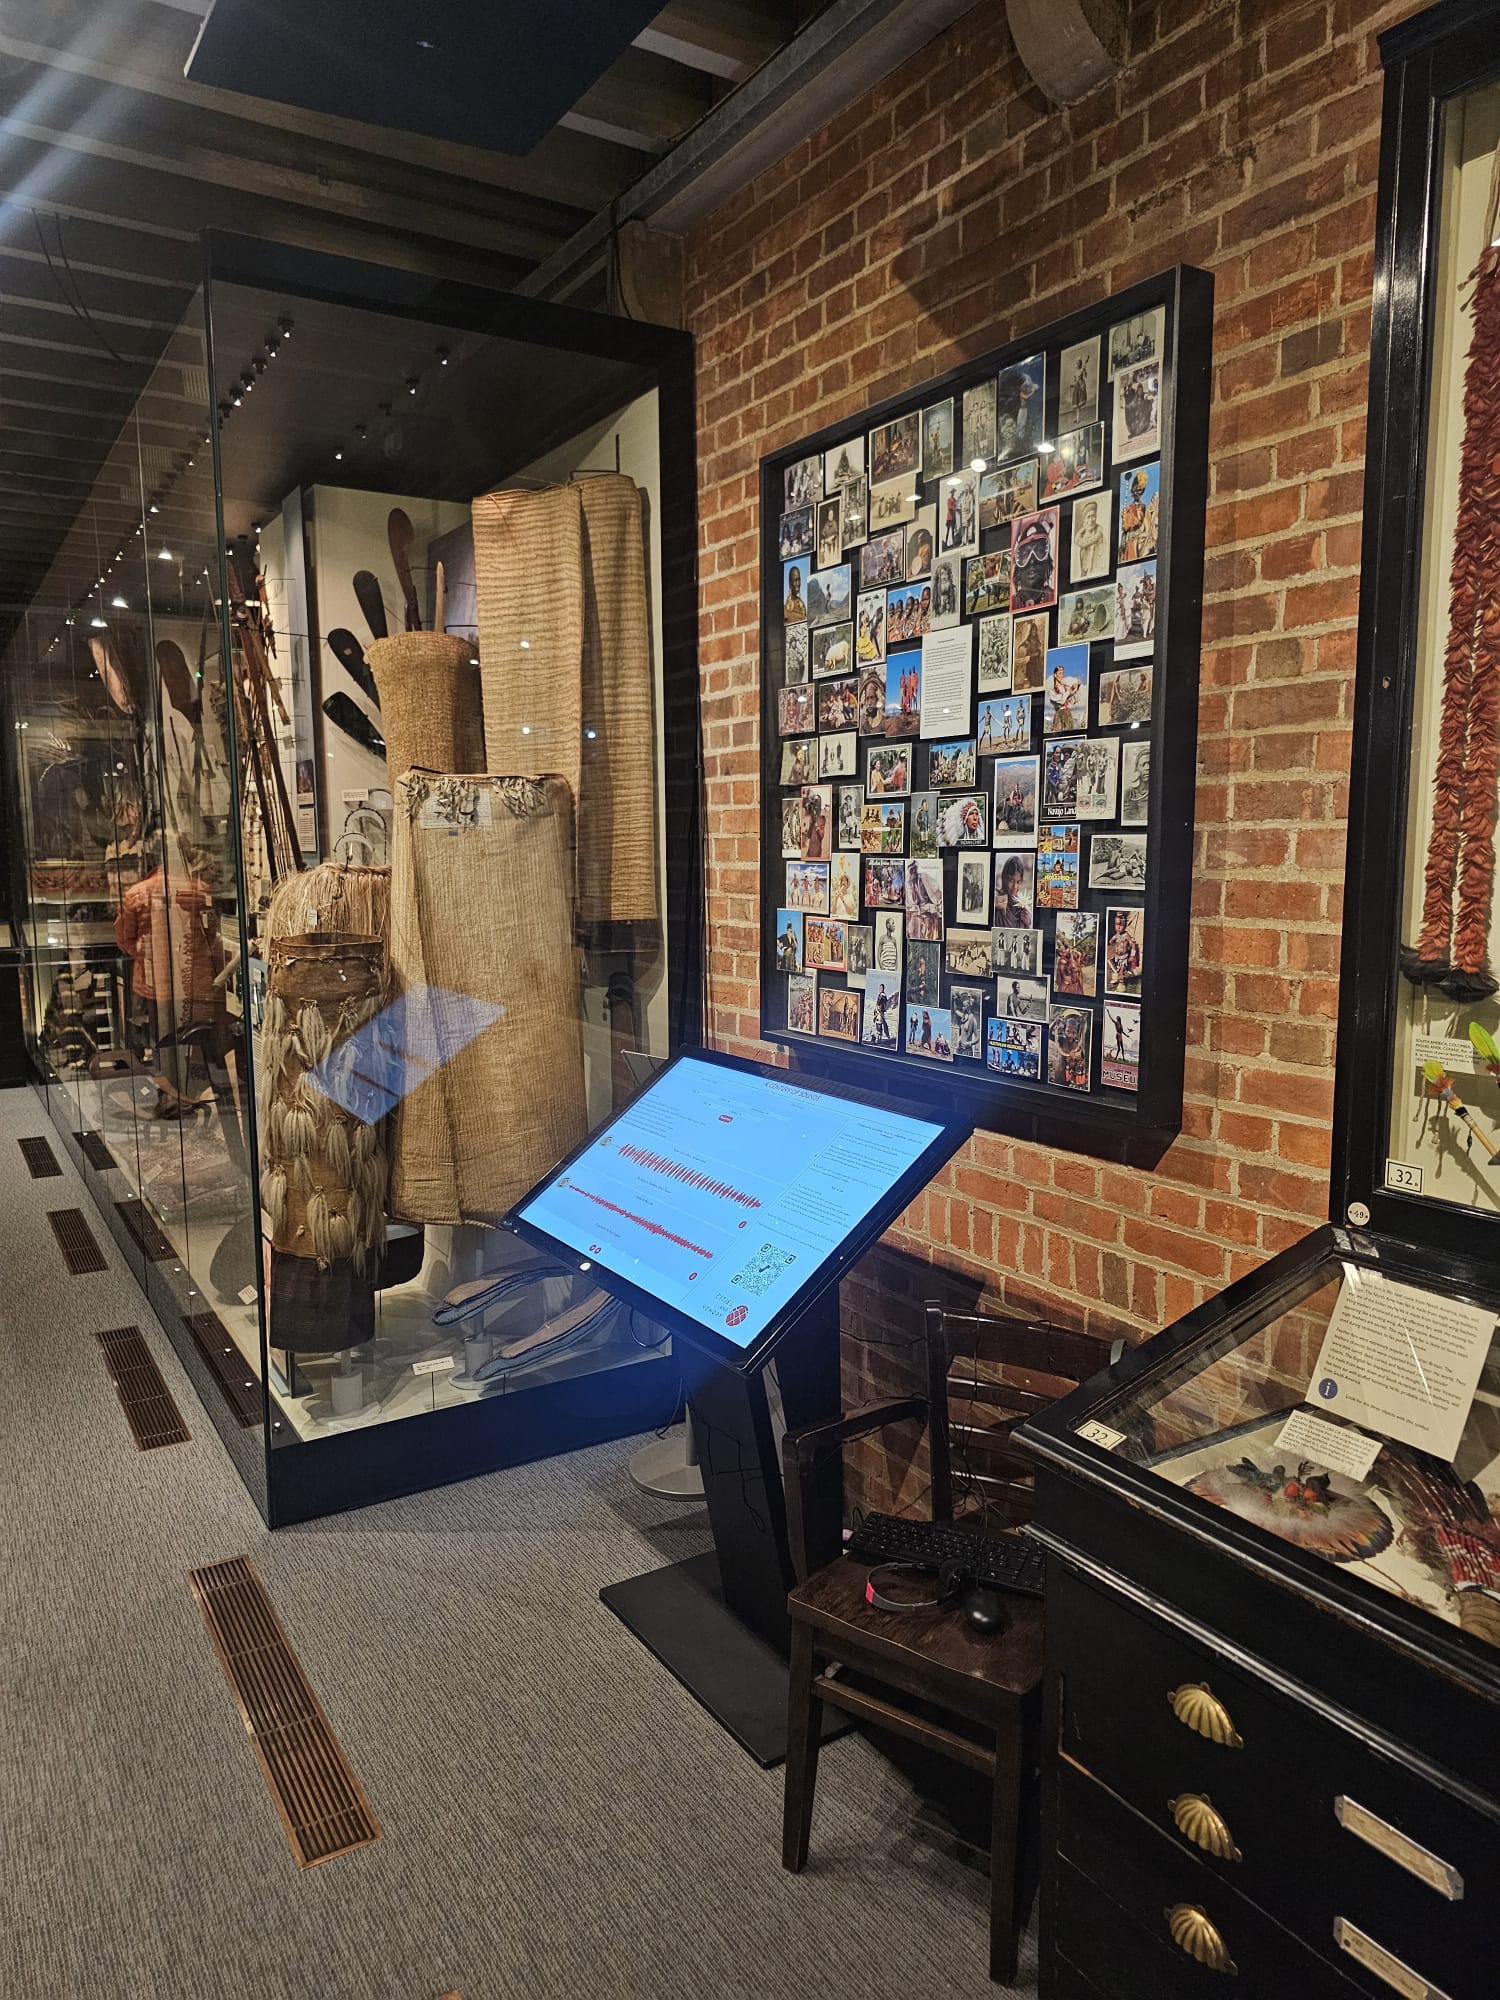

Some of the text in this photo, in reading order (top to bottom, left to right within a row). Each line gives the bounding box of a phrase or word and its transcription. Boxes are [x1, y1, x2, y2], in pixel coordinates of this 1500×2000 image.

[1048, 807, 1076, 816] Navajo Land
[1102, 1069, 1136, 1084] MUSEU
[1396, 1169, 1413, 1186] 32
[1086, 1428, 1108, 1443] 32
